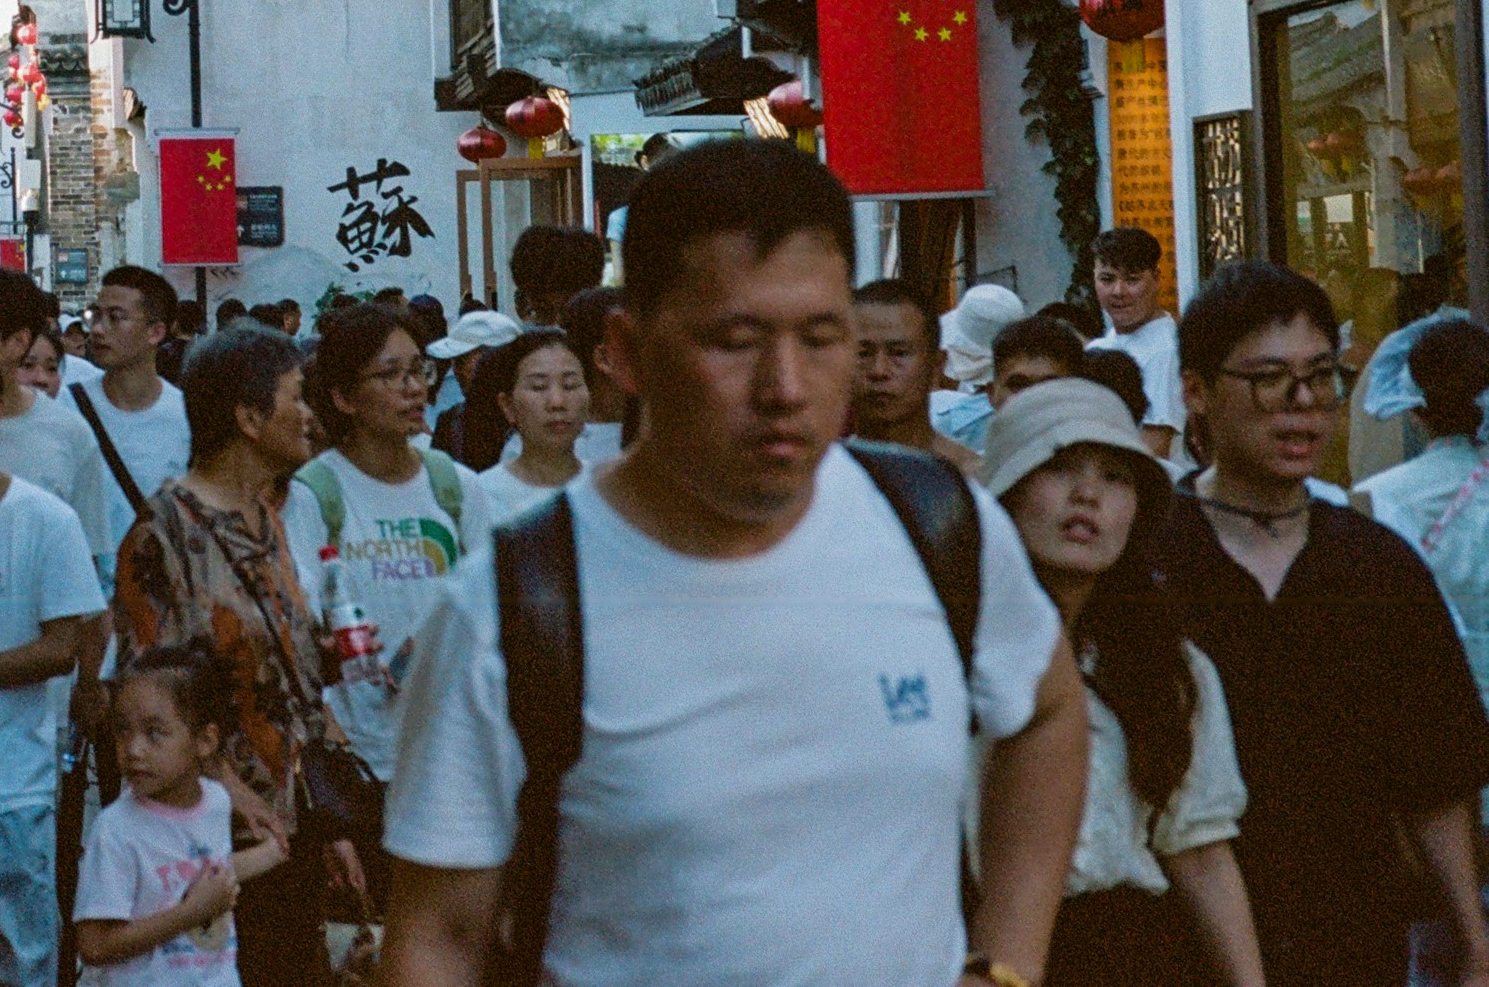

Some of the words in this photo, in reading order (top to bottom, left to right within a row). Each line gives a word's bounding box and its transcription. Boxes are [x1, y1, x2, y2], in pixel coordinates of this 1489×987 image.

[326, 158, 436, 272] 蘇
[375, 517, 419, 539] THE
[345, 538, 421, 561] NORTH
[371, 558, 424, 580] FACE
